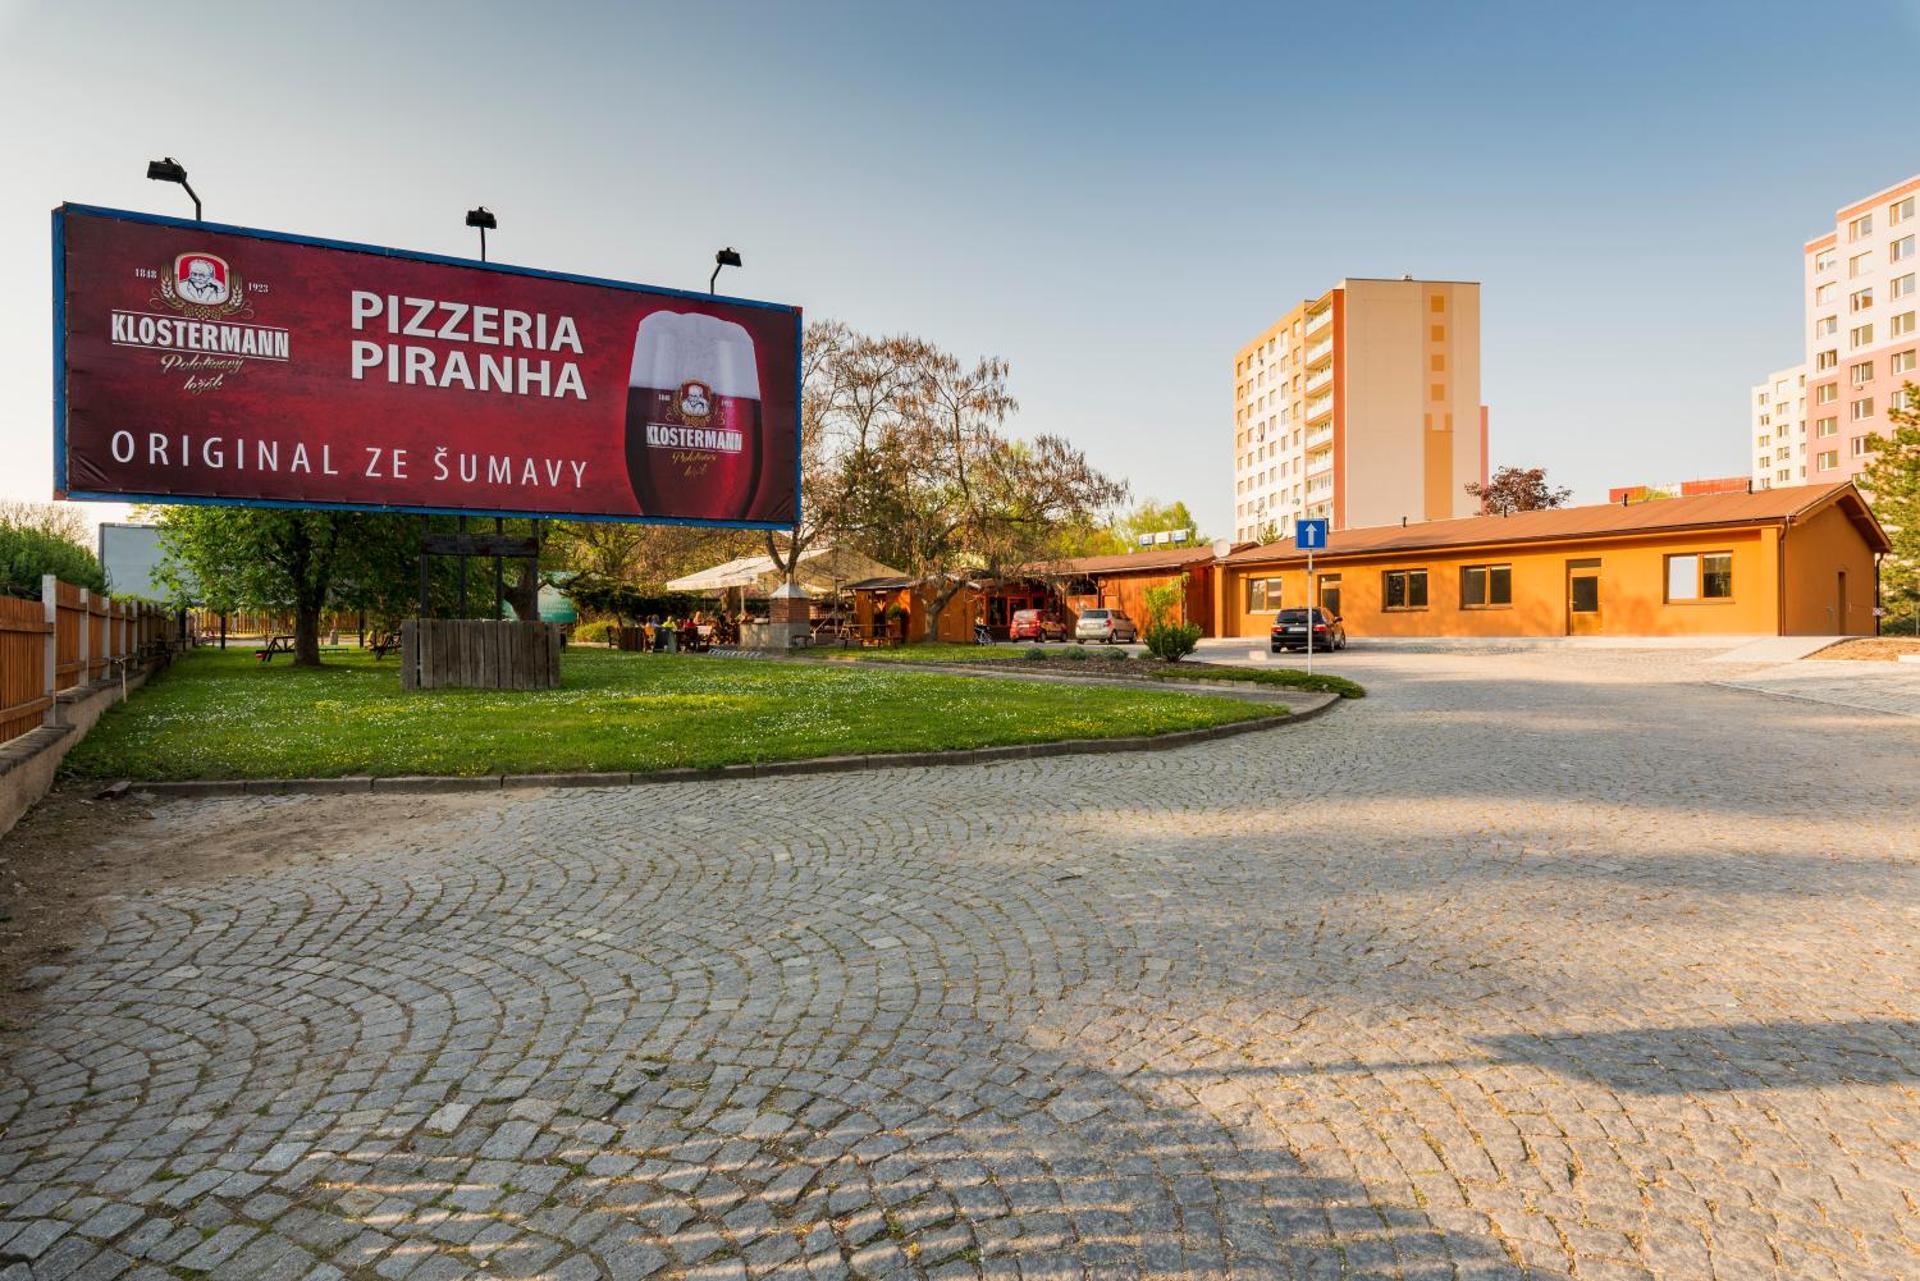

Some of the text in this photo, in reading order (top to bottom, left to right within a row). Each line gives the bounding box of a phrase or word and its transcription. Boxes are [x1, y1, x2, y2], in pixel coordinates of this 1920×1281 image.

[248, 282, 269, 293] 1923
[112, 313, 289, 358] KLOSTERMANN
[351, 290, 583, 354] PIZZERIA
[351, 340, 588, 400] PIRANHA
[111, 430, 588, 488] ORIGINAL ZE ŠUMAVY
[646, 425, 743, 451] KLOSTERMANN
